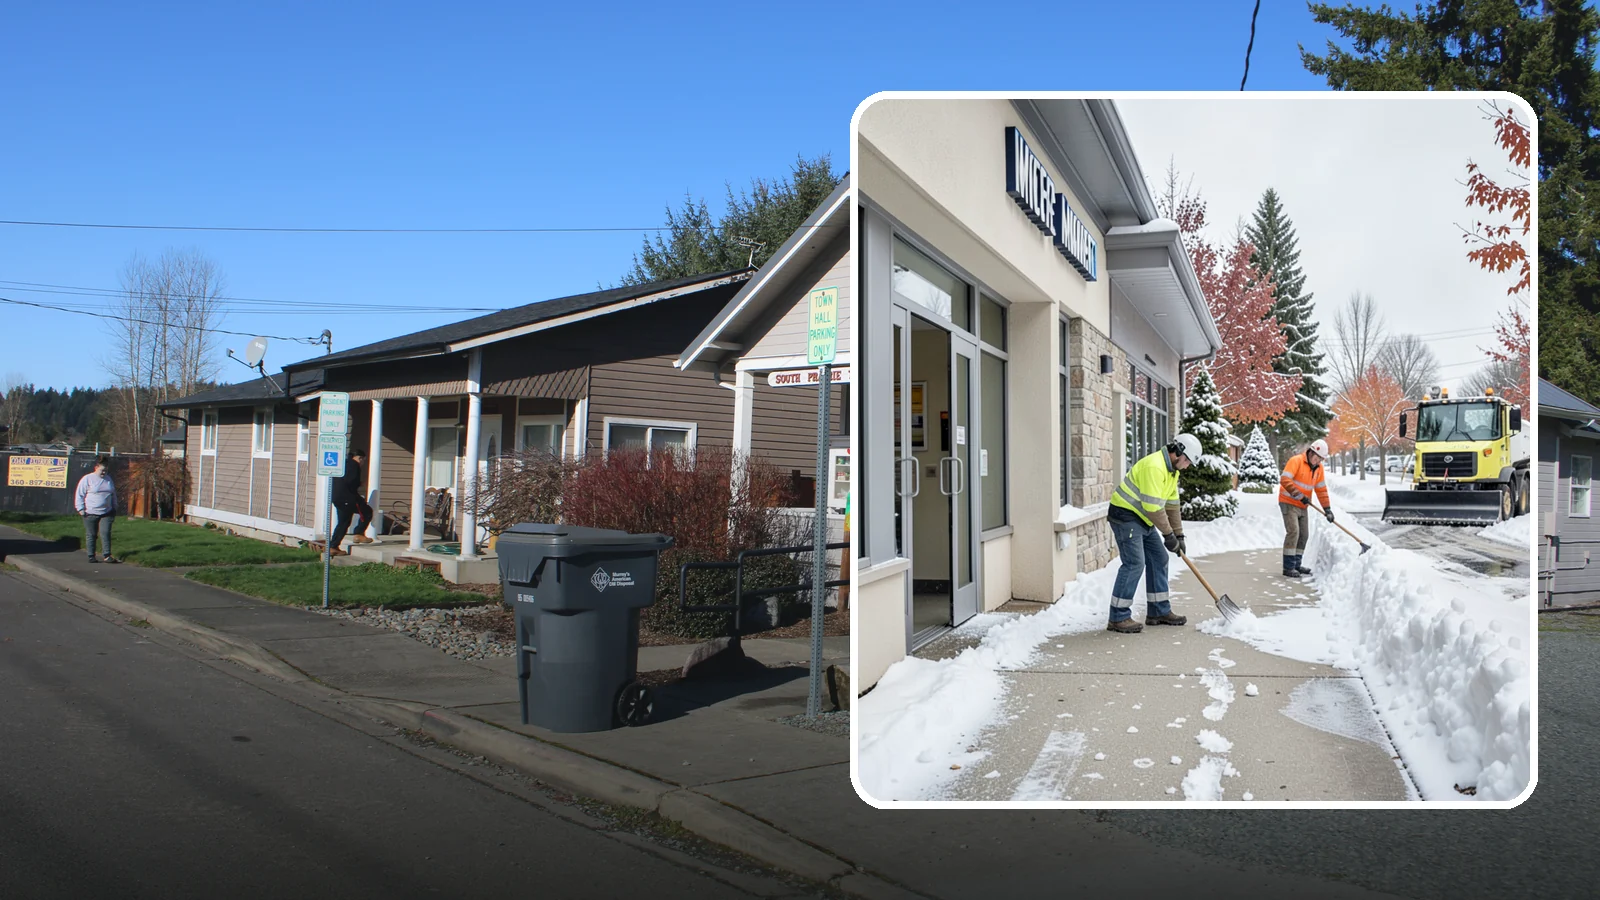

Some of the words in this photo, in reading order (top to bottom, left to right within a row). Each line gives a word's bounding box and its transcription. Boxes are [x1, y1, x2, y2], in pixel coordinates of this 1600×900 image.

[815, 295, 833, 308] TOWN
[814, 311, 831, 324] HALL
[809, 326, 836, 340] PARKING
[813, 344, 831, 357] ONLY
[775, 373, 801, 384] SOUTH
[807, 370, 842, 382] PRIE
